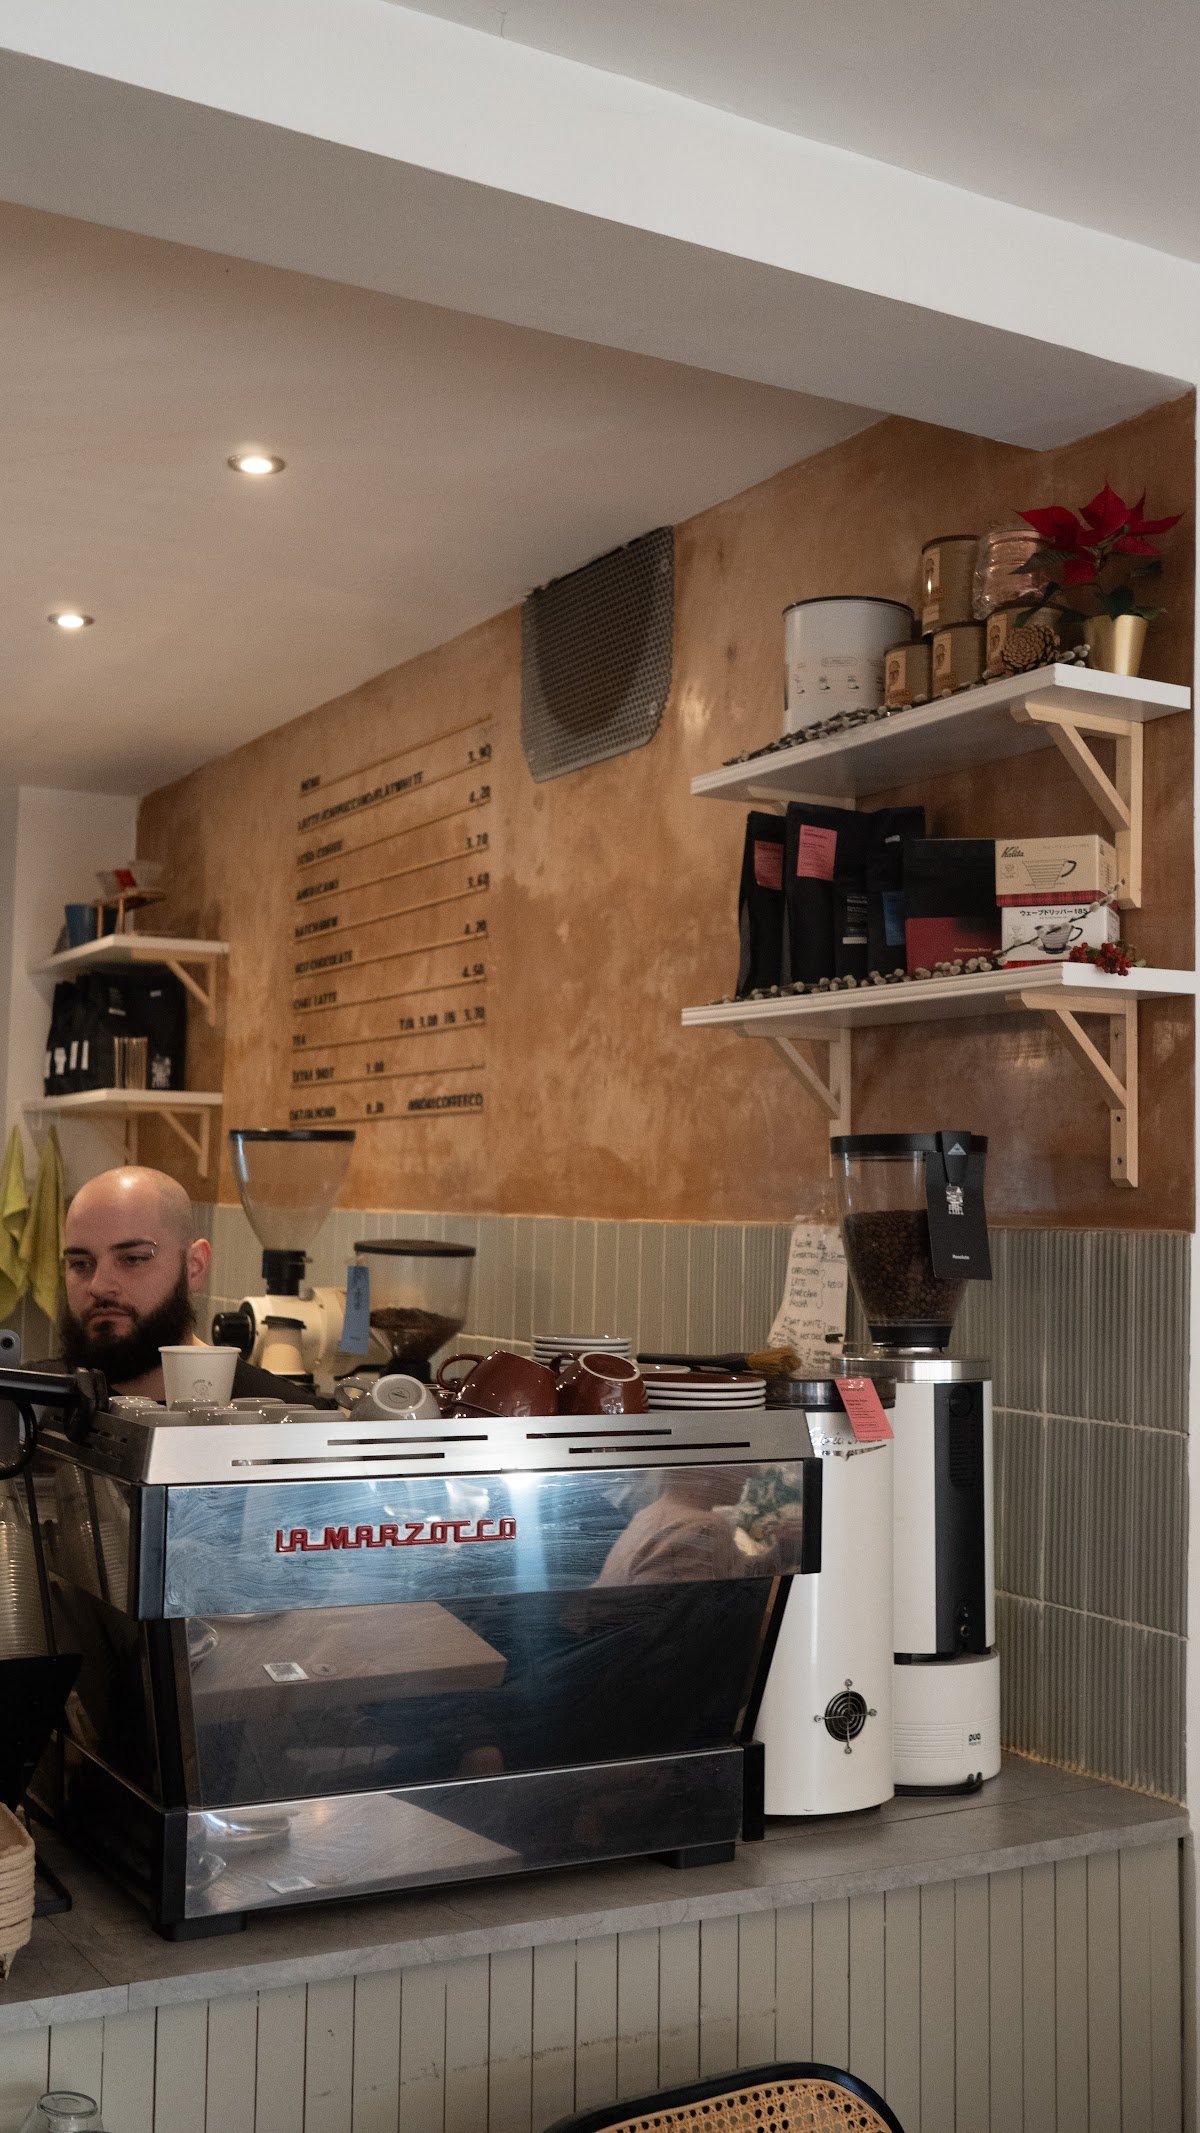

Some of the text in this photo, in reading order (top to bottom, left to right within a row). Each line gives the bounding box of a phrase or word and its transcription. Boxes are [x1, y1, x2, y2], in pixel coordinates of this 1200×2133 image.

[1001, 846, 1024, 858] Kalita
[314, 991, 338, 1005] LATTE
[276, 1518, 517, 1553] LA MARZOCCO
